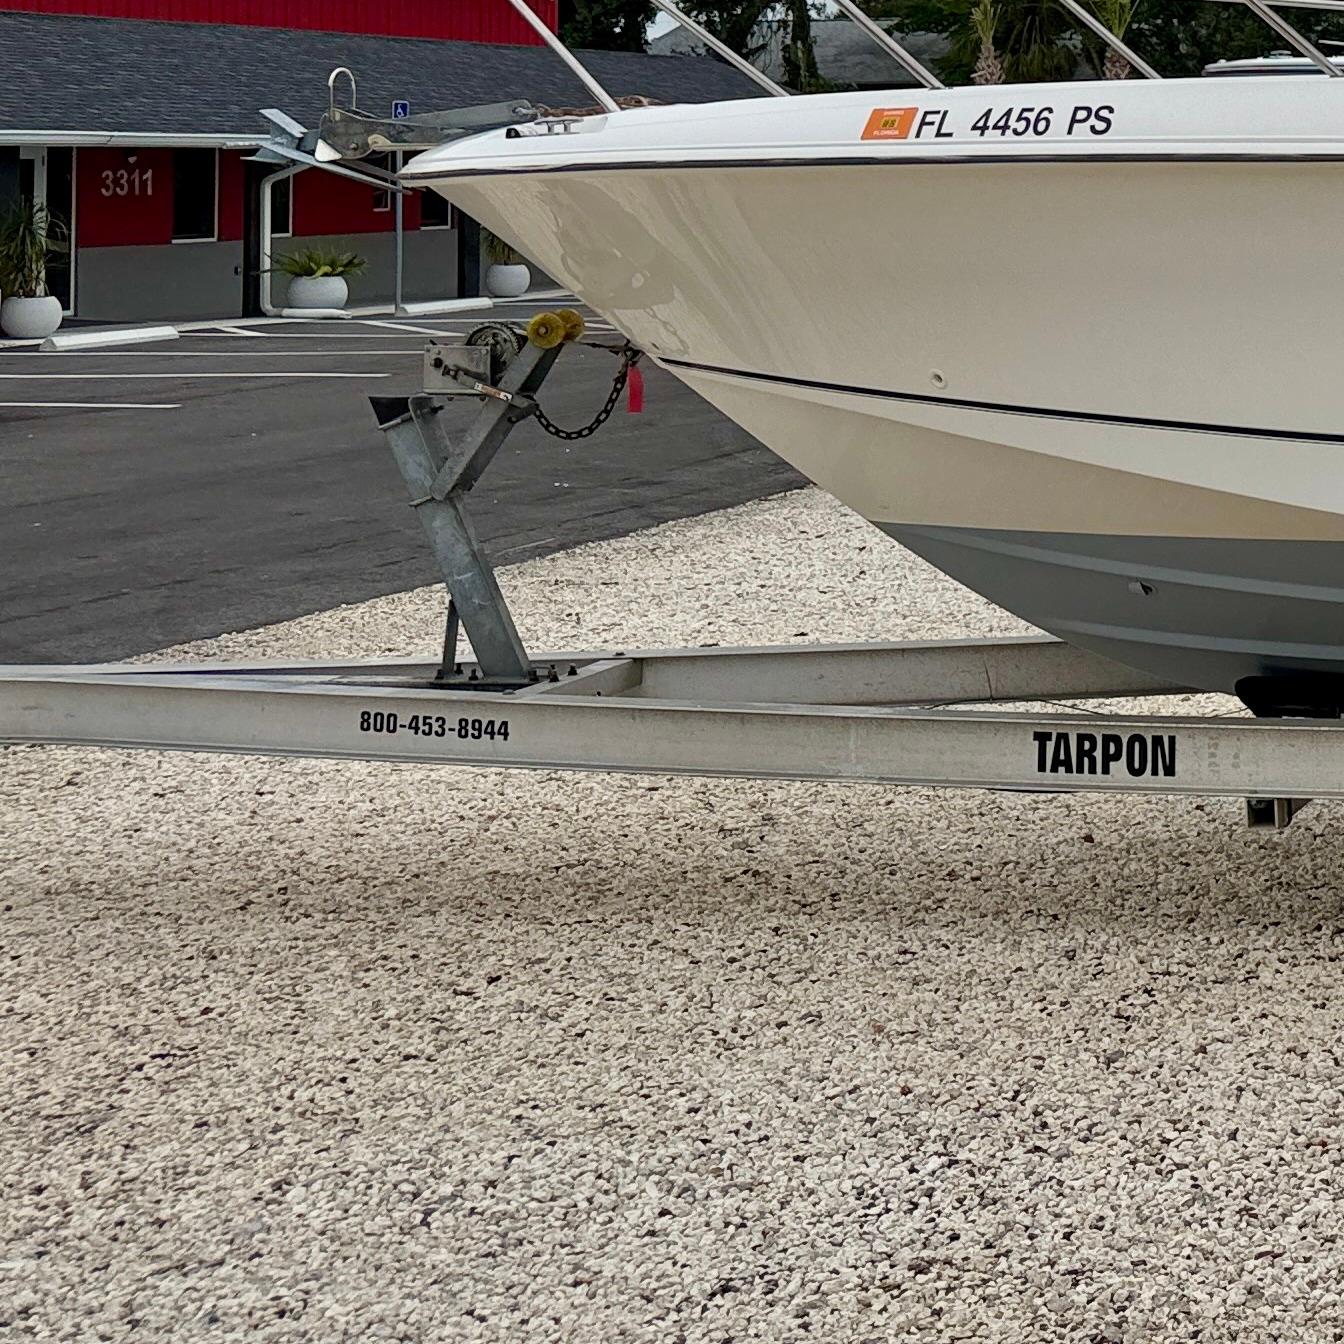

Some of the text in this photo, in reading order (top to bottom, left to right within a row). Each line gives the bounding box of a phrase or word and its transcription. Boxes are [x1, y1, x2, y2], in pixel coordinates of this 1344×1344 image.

[915, 105, 1115, 138] FL 4456 PS
[101, 169, 152, 196] 3311
[360, 711, 509, 741] 800-453-8944
[1033, 731, 1176, 777] TARPON
